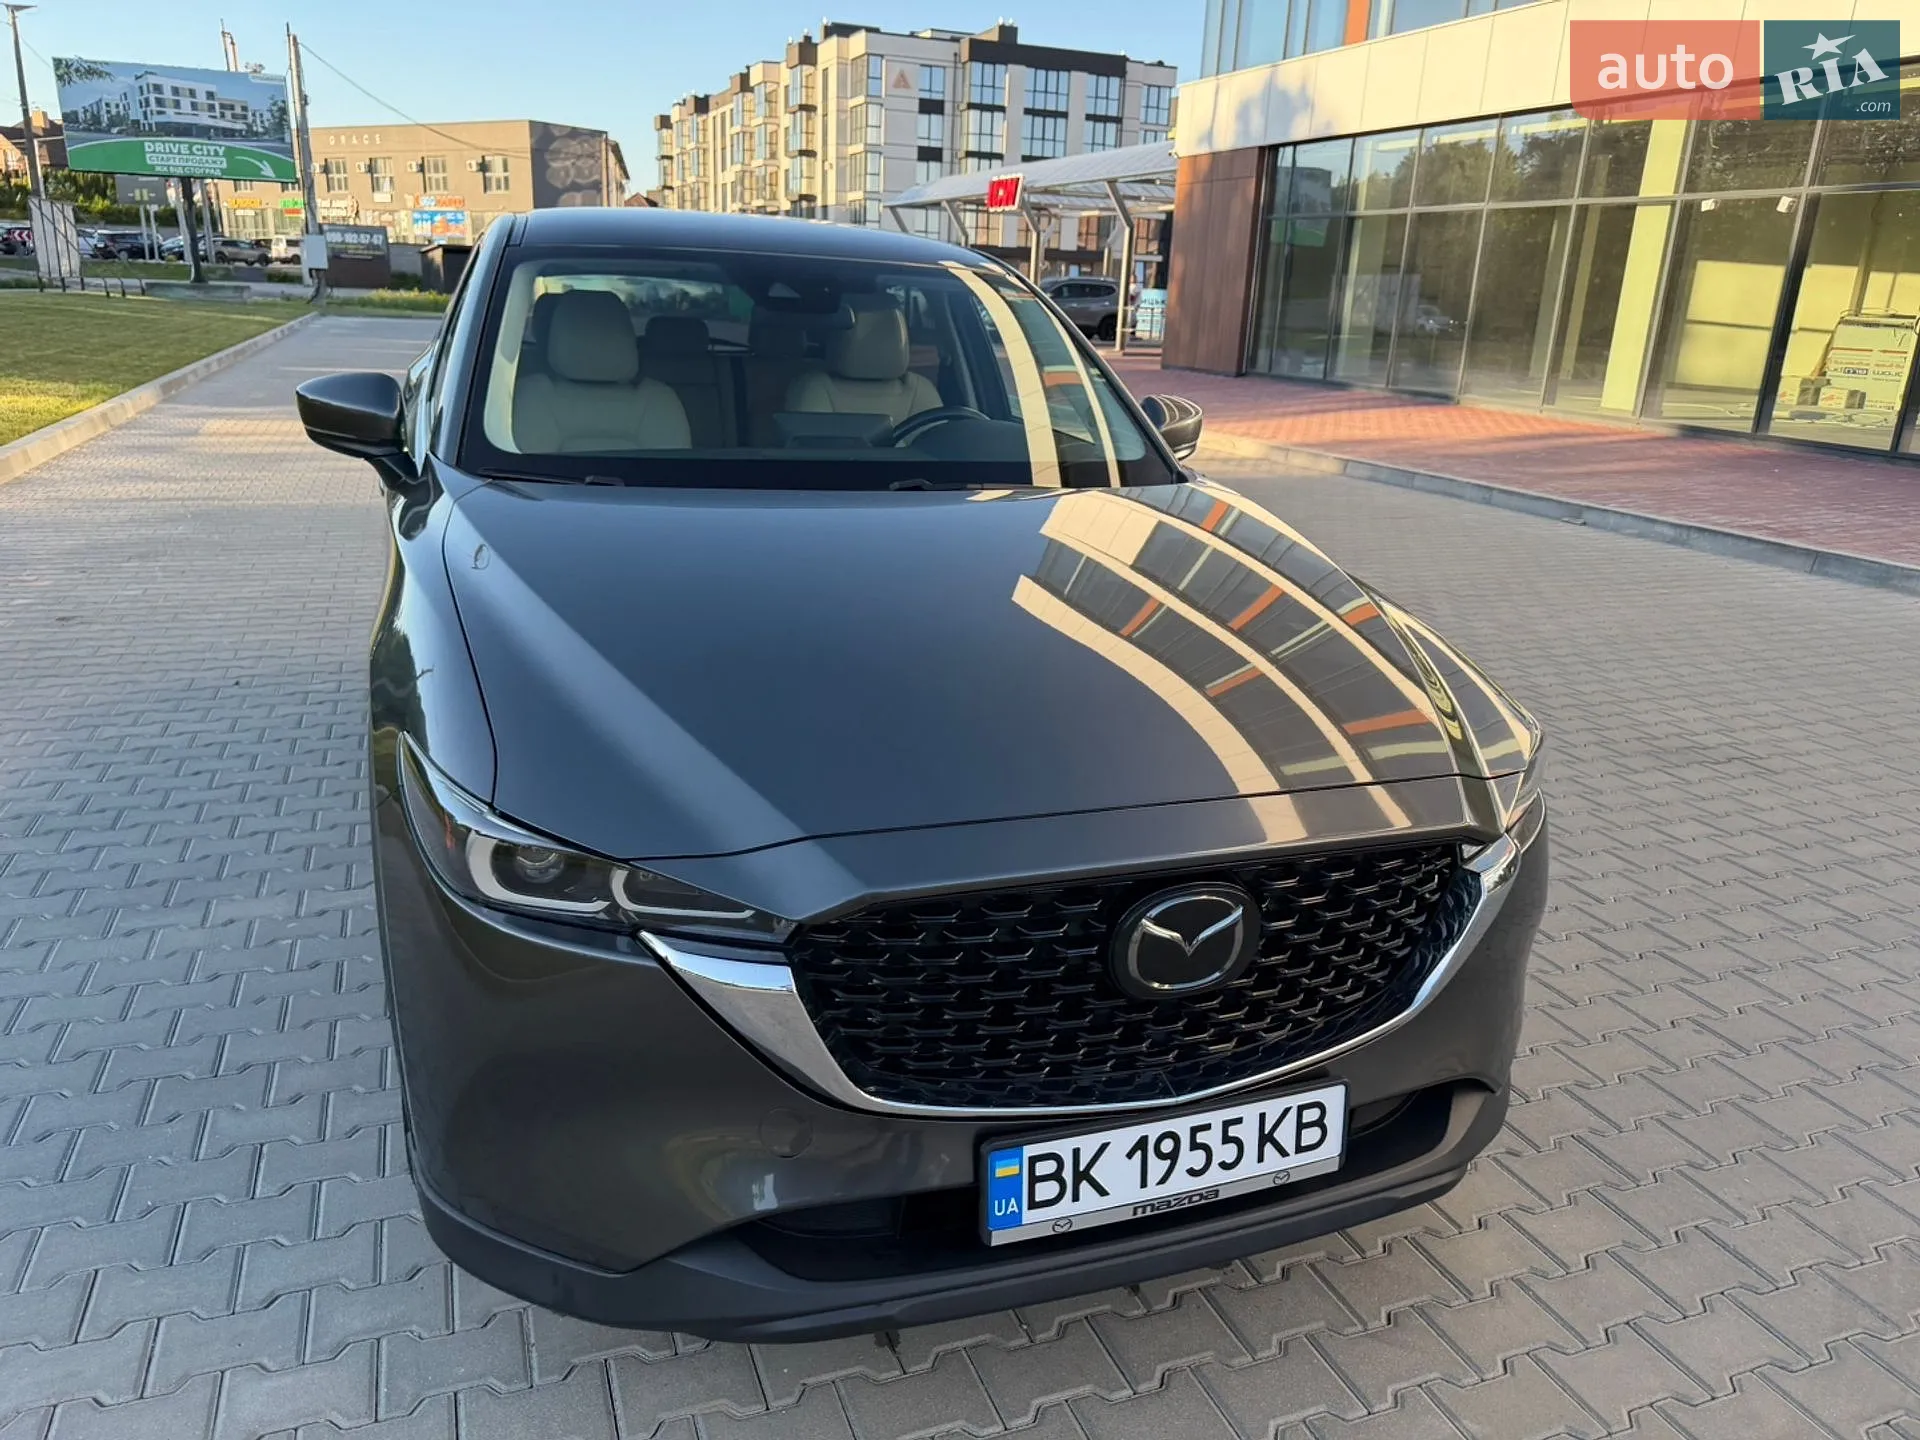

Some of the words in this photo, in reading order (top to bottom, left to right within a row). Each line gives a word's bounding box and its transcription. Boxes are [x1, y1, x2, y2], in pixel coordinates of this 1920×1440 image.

[143, 141, 190, 155] DRIVE
[191, 144, 226, 157] CITY
[148, 154, 178, 164] СТАРТ
[1026, 1140, 1112, 1211] BK
[1125, 1115, 1246, 1190] 1955
[1256, 1099, 1329, 1164] KB
[993, 1197, 1020, 1217] UA
[1131, 1188, 1221, 1218] mazda
